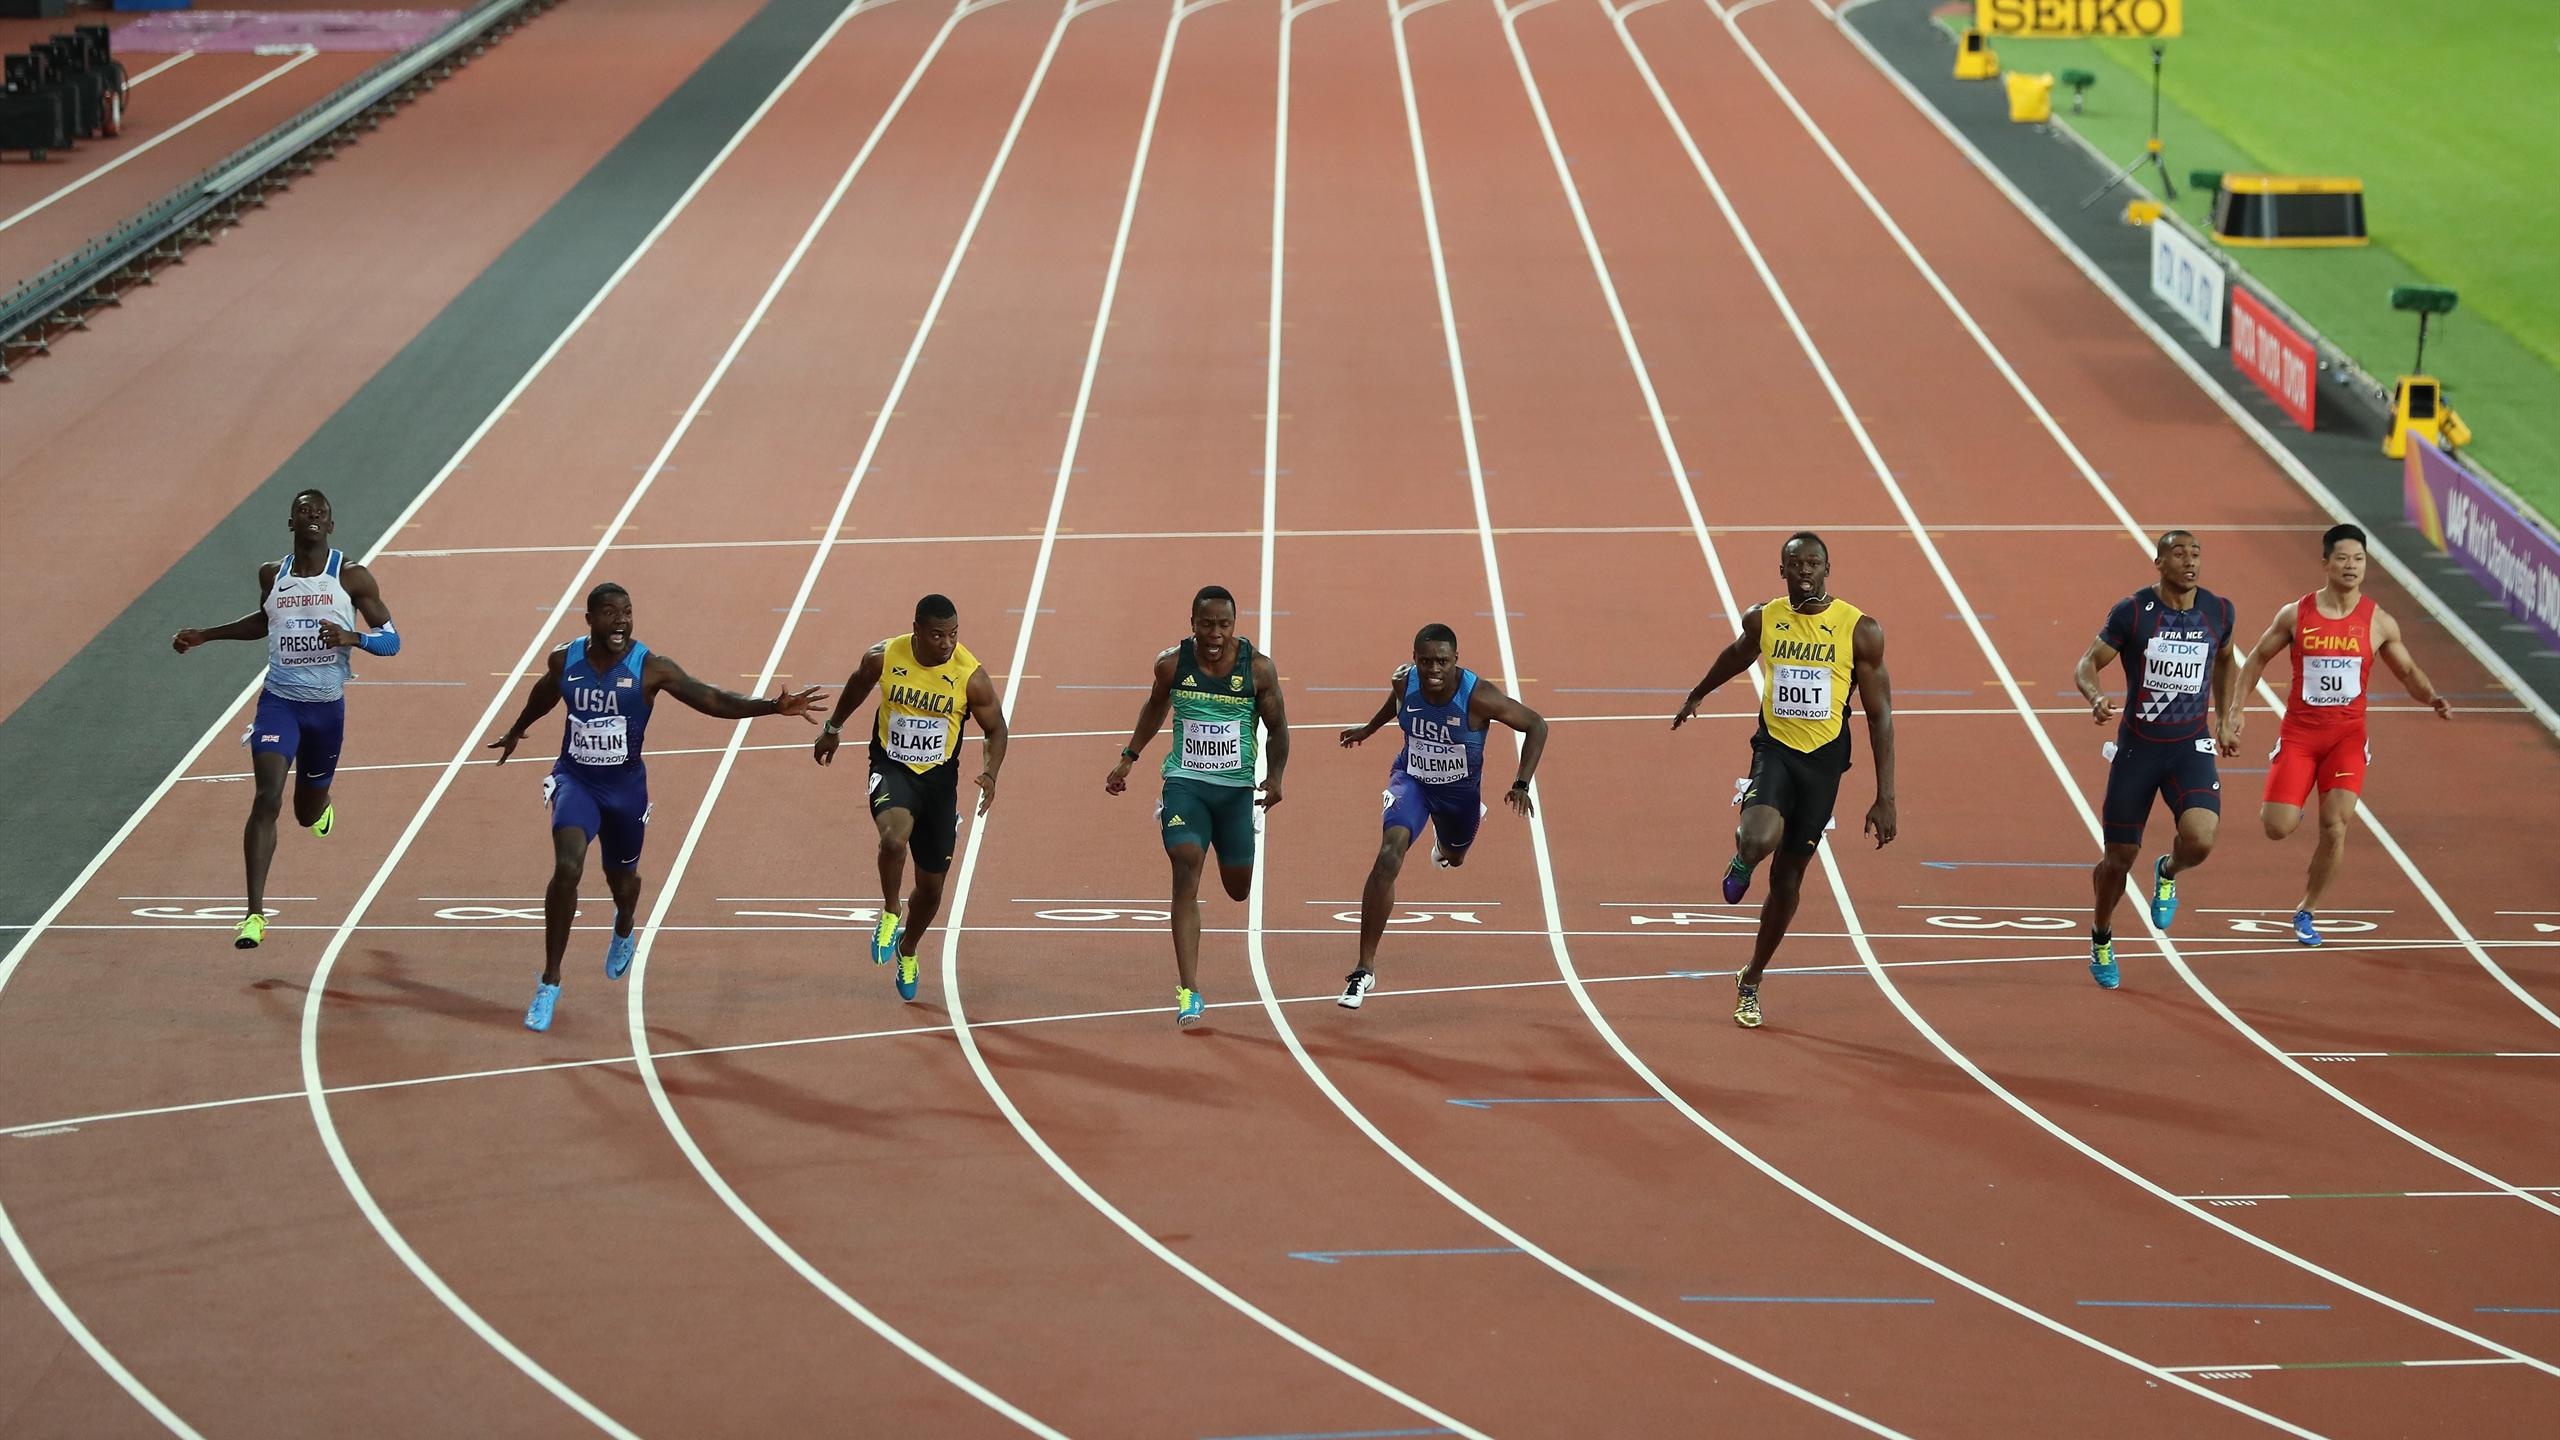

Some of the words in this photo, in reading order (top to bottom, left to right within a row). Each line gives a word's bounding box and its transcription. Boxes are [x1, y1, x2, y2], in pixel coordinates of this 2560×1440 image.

[1992, 0, 2167, 33] SEIKO
[277, 595, 301, 608] GREAT
[301, 594, 333, 606] BRITAIN
[280, 636, 332, 652] PRESCO
[1771, 640, 1836, 662] JAMAICA
[2168, 644, 2199, 655] TDK
[2303, 636, 2360, 652] CHINA
[281, 657, 316, 665] LONDON
[316, 655, 335, 663] 2017
[2321, 659, 2352, 668] TDK
[1790, 669, 1821, 680] TDK
[2150, 659, 2202, 679] VICAUT
[2146, 679, 2182, 690] LONDON
[2320, 676, 2342, 691] SU
[574, 687, 619, 715] USA
[888, 685, 954, 714] JAMAICA
[1175, 689, 1211, 702] SOUTH
[1212, 694, 1248, 705] AFRICA
[1779, 686, 1822, 704] BOLT
[1774, 707, 1808, 717] LONDON
[1809, 710, 1829, 718] 2017
[906, 719, 939, 729] TDK
[1199, 724, 1231, 734] TDK
[1411, 717, 1455, 744] USA
[573, 732, 623, 750] GATLIN
[891, 731, 942, 750] BLAKE
[1185, 738, 1237, 756] SIMBINE
[888, 750, 924, 762] LONDON
[924, 753, 942, 763] 2017
[1424, 744, 1455, 754] TDK
[1183, 760, 1219, 769] LONDON
[1220, 760, 1239, 769] 2017
[1410, 753, 1464, 772] COLEMAN
